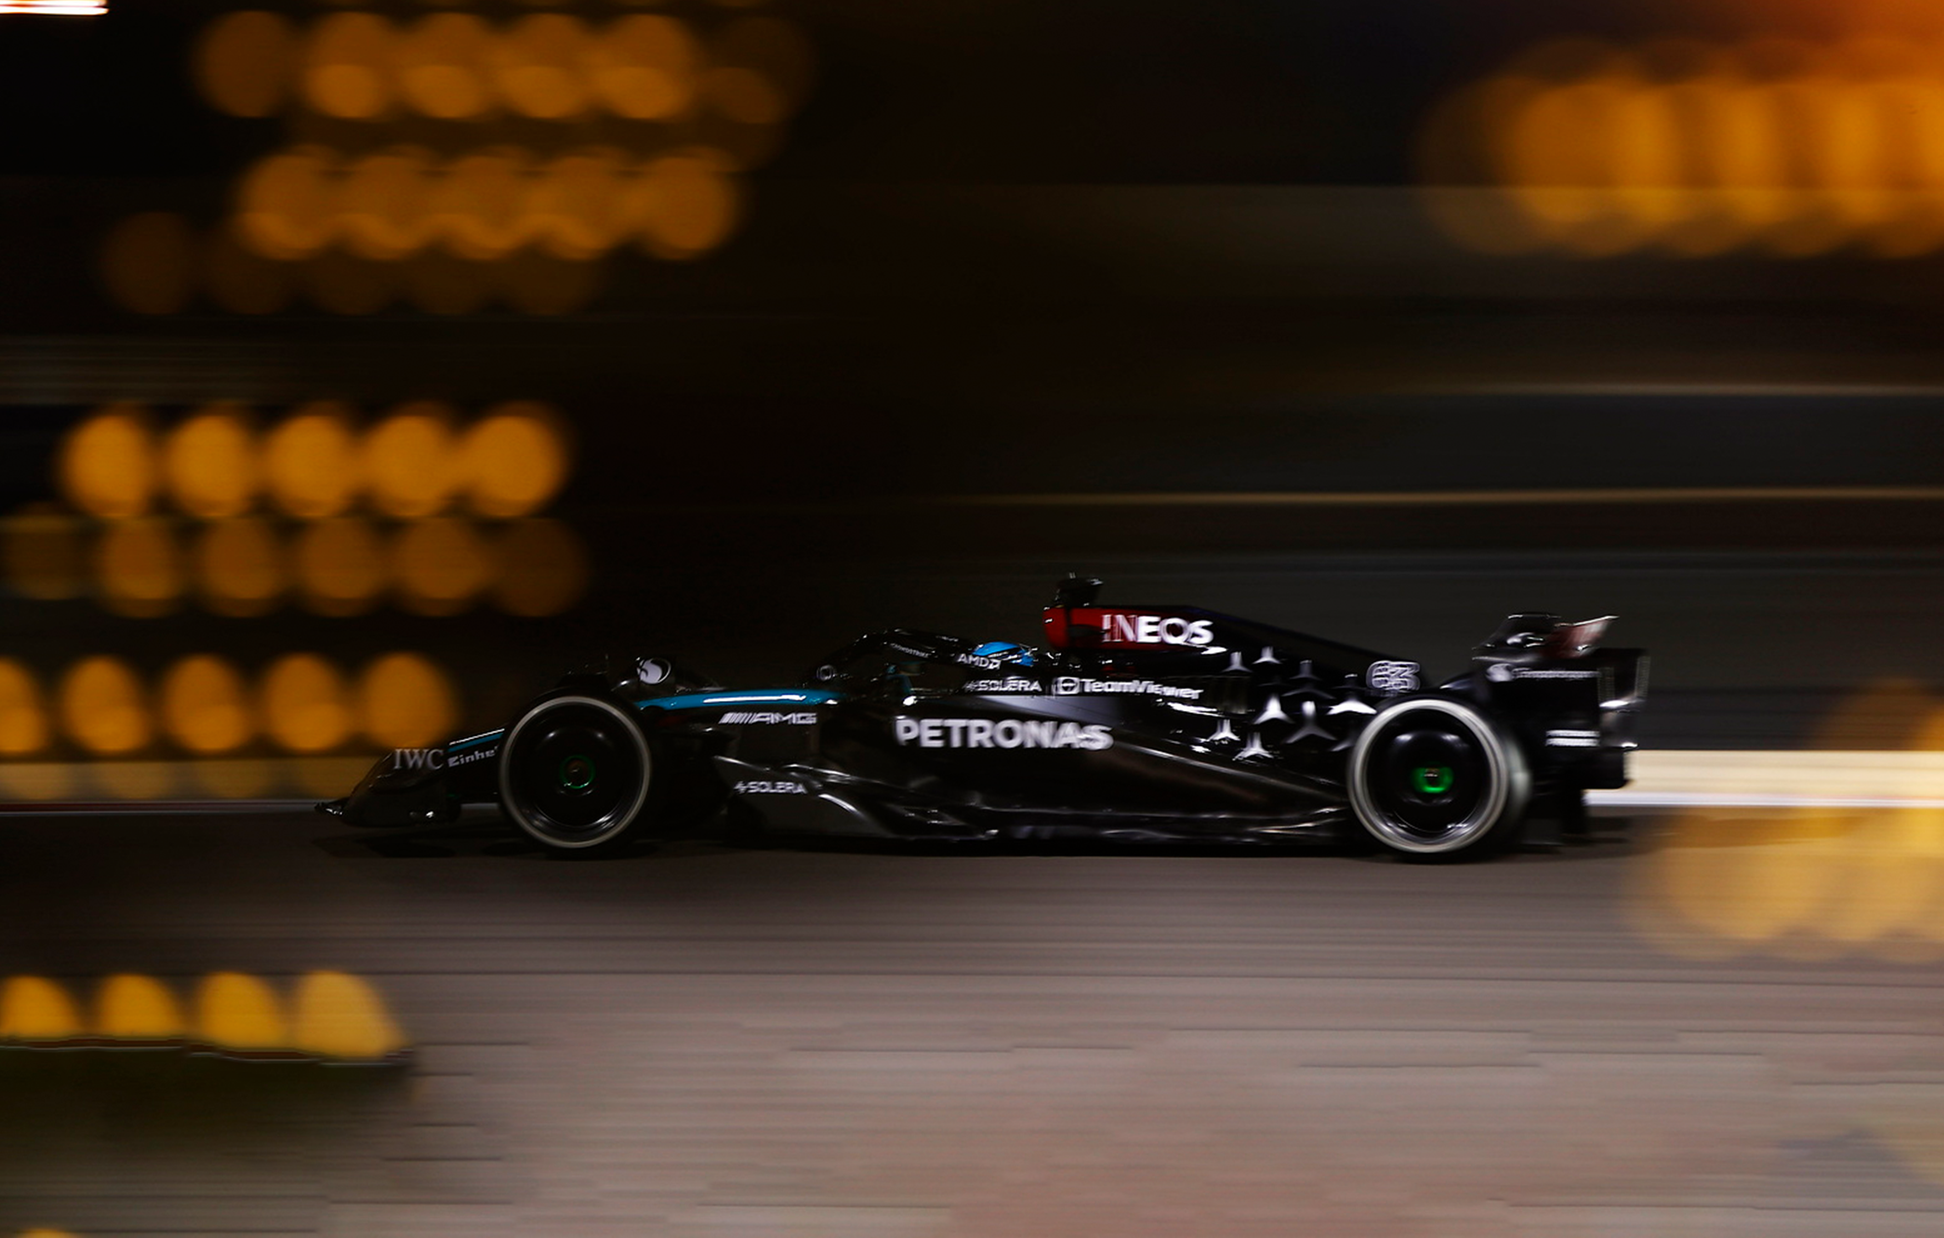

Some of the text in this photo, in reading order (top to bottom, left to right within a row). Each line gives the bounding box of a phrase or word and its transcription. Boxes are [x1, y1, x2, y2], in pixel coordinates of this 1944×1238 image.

[1101, 614, 1214, 645] INEOS
[956, 653, 989, 669] AMD
[976, 679, 1042, 692] SOLERA
[1080, 678, 1204, 700] TeamViewer
[752, 712, 817, 725] AMG
[895, 717, 1114, 750] PETRONAS
[393, 748, 444, 770] IWC
[747, 781, 808, 794] SOLERA
